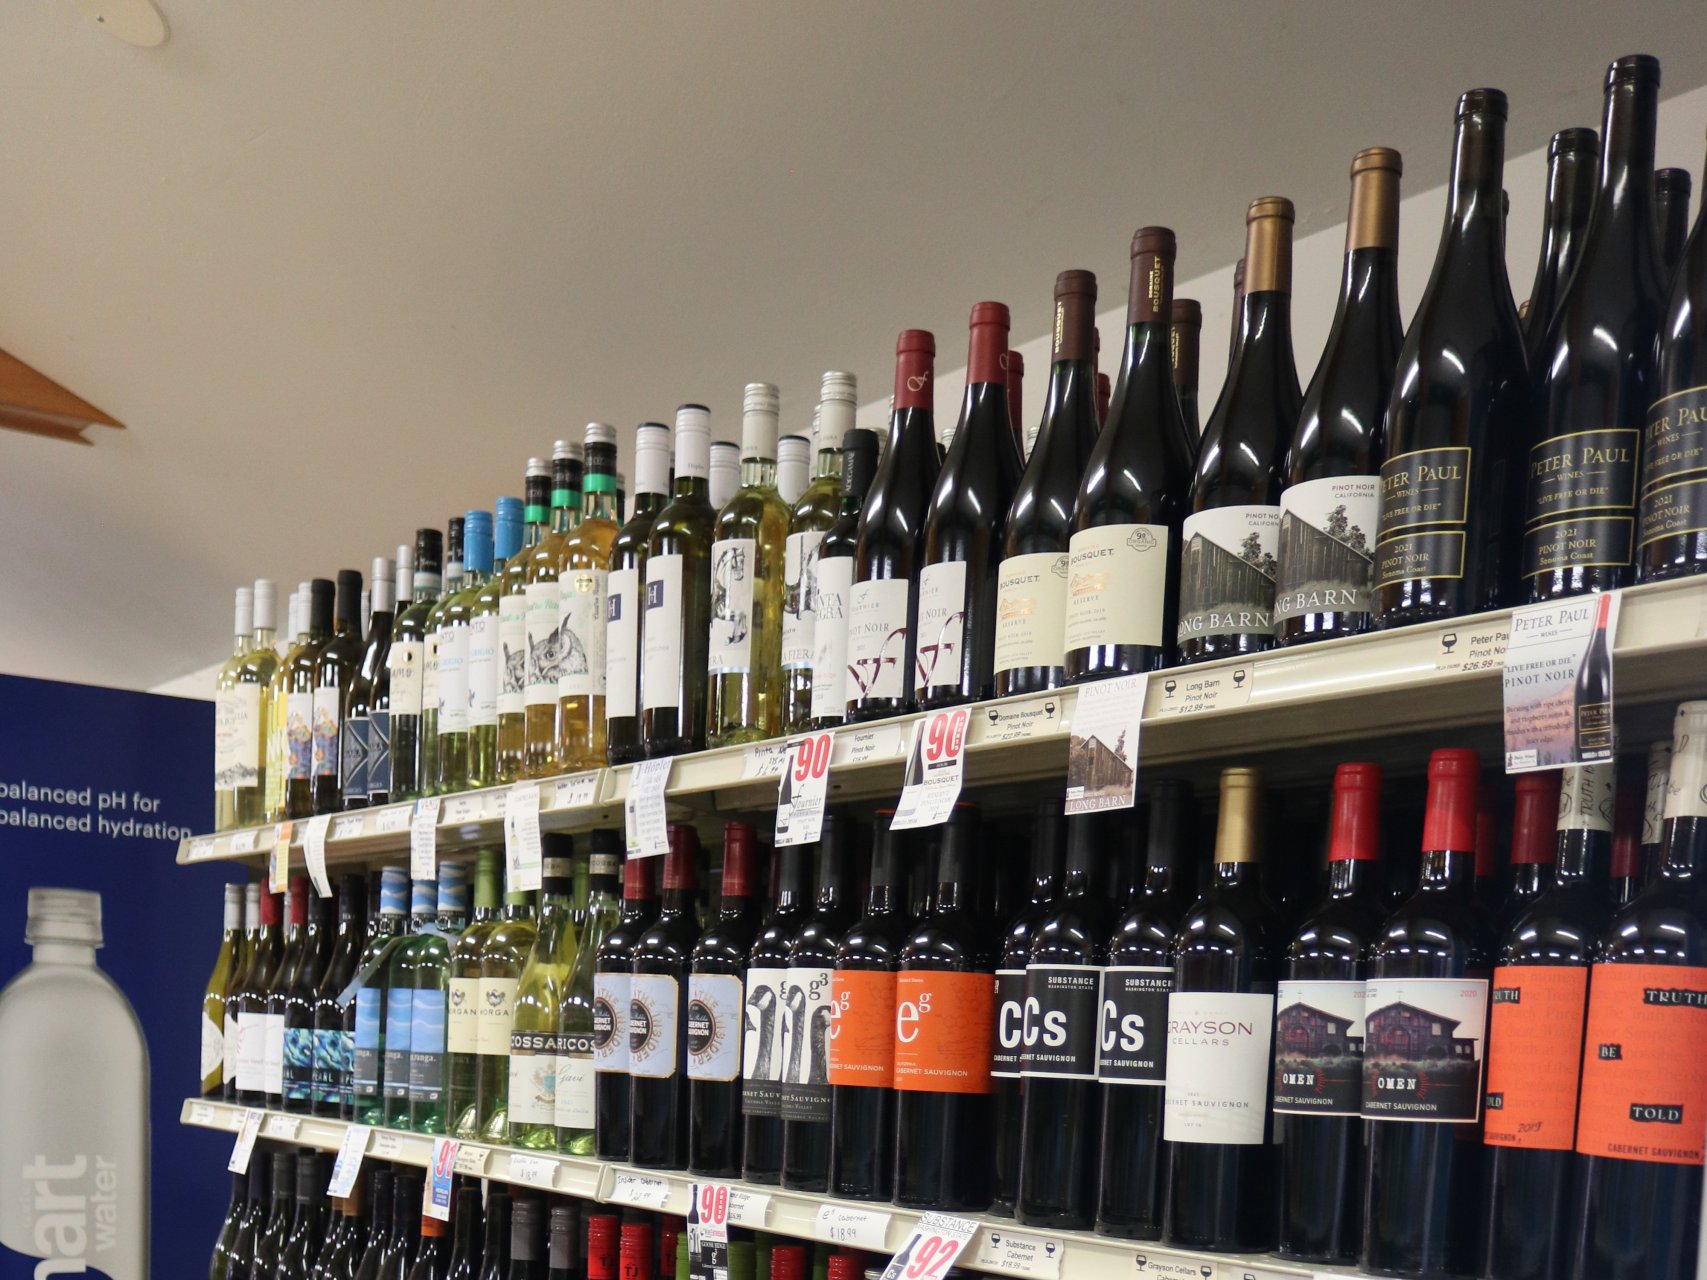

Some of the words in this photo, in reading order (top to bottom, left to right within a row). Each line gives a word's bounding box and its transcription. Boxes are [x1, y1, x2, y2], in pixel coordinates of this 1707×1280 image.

[1657, 432, 1679, 447] WINES
[1530, 454, 1571, 478] PETER
[1583, 447, 1630, 464] PAUL
[1418, 466, 1461, 481] PAUL
[1557, 470, 1584, 481] WINES
[1332, 484, 1354, 492] PINOT
[1397, 488, 1419, 497] WINES
[1555, 529, 1577, 538] 2021
[1395, 544, 1412, 553] 2021
[1539, 542, 1566, 555] PINOT
[1569, 538, 1596, 549] NOIR
[1405, 553, 1429, 564] NOIR
[1570, 551, 1593, 560] Coast
[1296, 588, 1358, 610] BARN
[926, 608, 947, 618] NOIR
[1208, 613, 1269, 630] BARN
[1515, 614, 1553, 632] PETER
[1560, 608, 1589, 624] PAUL
[865, 623, 890, 633] NOIR
[1470, 633, 1496, 645] Peter
[1469, 649, 1492, 660] Pinot
[1462, 659, 1493, 672] $26.99
[1526, 661, 1545, 671] FREE
[1546, 659, 1557, 667] OR
[1505, 674, 1539, 688] PINOT
[1545, 669, 1575, 682] NOIR
[1186, 682, 1204, 692] Long
[1205, 679, 1220, 689] Barn
[1185, 694, 1202, 702] Pinot
[1204, 691, 1218, 700] Noir
[999, 712, 1020, 721] Domaine
[1021, 709, 1043, 720] Bousquet
[1179, 705, 1203, 714] $12.99
[926, 710, 968, 762] 90
[795, 734, 831, 782] 90
[923, 775, 959, 786] BOUSQUET
[98, 790, 126, 811] pH
[133, 792, 160, 813] for
[1070, 798, 1097, 812] LONG
[1099, 795, 1126, 806] BARN
[98, 814, 191, 840] hydration
[1048, 976, 1094, 986] SUBSTANCE
[1125, 979, 1173, 988] SUBSTANCE
[1647, 990, 1707, 1005] TRUTH
[1601, 1047, 1616, 1057] BE
[1036, 1055, 1076, 1063] SAUVIGNON
[1114, 1060, 1154, 1068] SAUVIGNON
[924, 1069, 968, 1077] SAUVIGNON
[1283, 1074, 1314, 1085] OMEN
[1378, 1077, 1416, 1089] OMEN
[1193, 1100, 1248, 1108] SAUVIGNON
[1295, 1097, 1333, 1105] SAUVIGNON
[1366, 1102, 1391, 1110] CABERNET
[1393, 1102, 1437, 1111] SAUVIGNON
[1633, 1107, 1679, 1121] TOLD
[1608, 1144, 1648, 1155] CABERNET
[1652, 1146, 1699, 1159] SAUVIGNON
[436, 1140, 458, 1178] 91
[95, 1155, 117, 1251] water
[701, 1185, 727, 1224] 90
[923, 1213, 976, 1232] SUBSTANCE
[1005, 1240, 1036, 1251] Substance
[907, 1236, 958, 1279] 92
[1007, 1251, 1033, 1261] Cabernet
[1148, 1262, 1173, 1274] Grayson
[1174, 1265, 1196, 1276] Cellars
